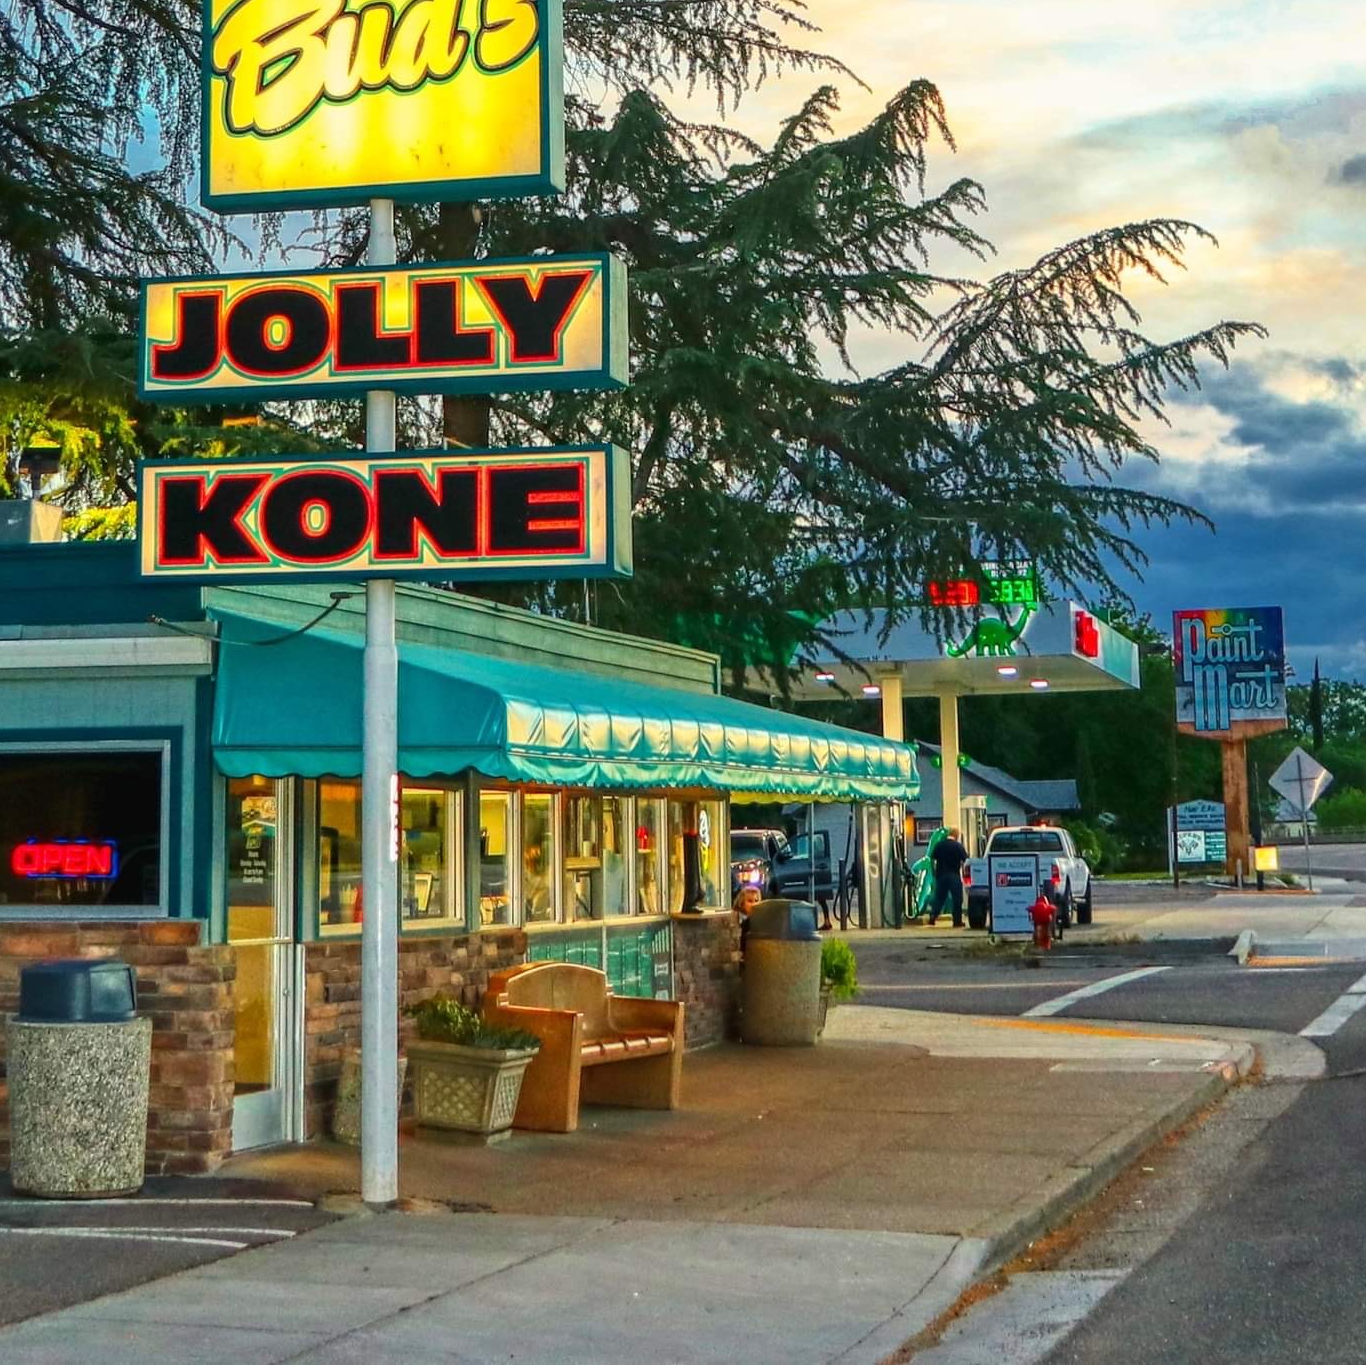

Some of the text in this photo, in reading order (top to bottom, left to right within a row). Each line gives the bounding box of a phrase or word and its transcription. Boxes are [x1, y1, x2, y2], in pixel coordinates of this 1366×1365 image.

[149, 269, 594, 382] JOLLY
[156, 460, 586, 568] KONE
[1181, 618, 1264, 682] Paint
[1194, 664, 1279, 730] Mart
[11, 843, 111, 875] OPEN
